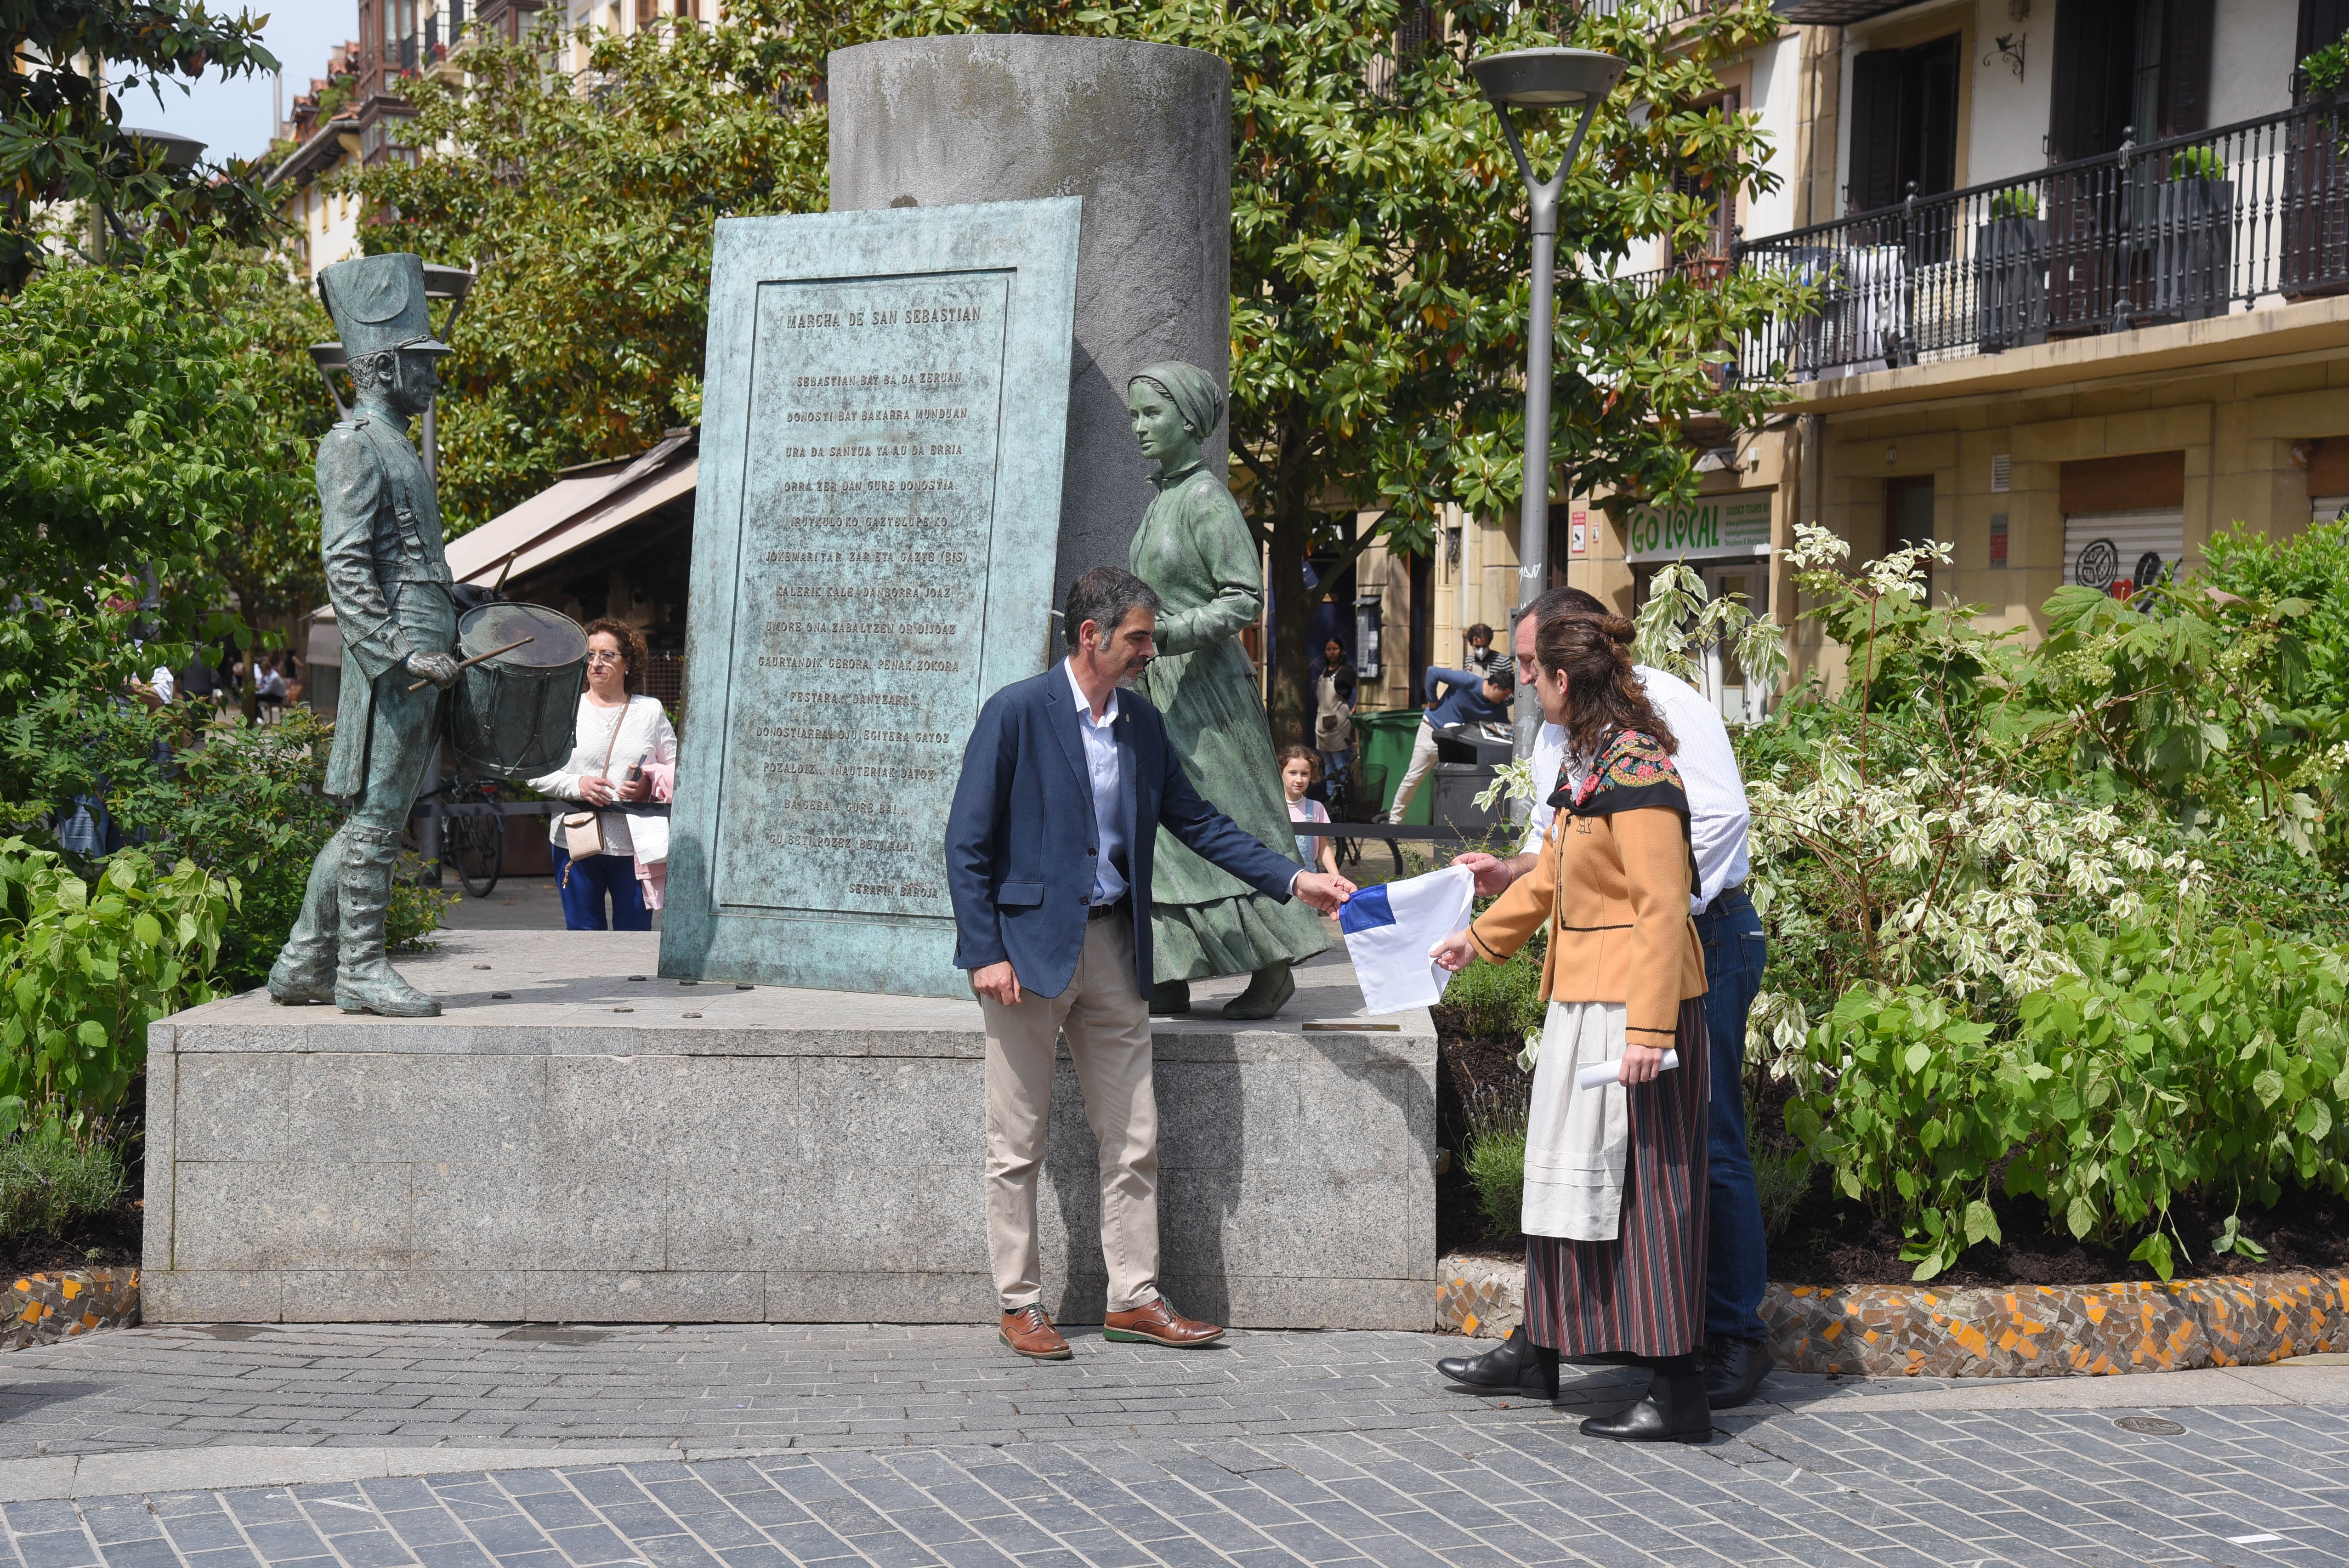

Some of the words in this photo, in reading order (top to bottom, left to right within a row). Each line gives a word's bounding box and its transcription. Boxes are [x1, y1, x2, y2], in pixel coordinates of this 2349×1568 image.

[787, 313, 840, 329] MARCHA
[849, 312, 864, 326] DE
[873, 311, 897, 325] SAN
[905, 306, 981, 324] SEBASTIAN
[797, 375, 856, 387] SEBASTIAN
[860, 375, 878, 386] BAT
[883, 374, 897, 385] BA
[902, 373, 915, 385] DA
[920, 372, 962, 384] ZERUAN
[787, 411, 833, 422] DONOSTI
[838, 411, 857, 422] BAT
[861, 409, 910, 421] BAKARRA
[915, 407, 968, 420] MUNDUAN
[786, 446, 806, 457] URA
[811, 446, 824, 457] DA
[829, 445, 872, 457] SANTUA
[877, 445, 889, 456] TA
[892, 445, 907, 456] AU
[911, 444, 925, 456] DA
[930, 443, 963, 455] ERRIA
[817, 481, 838, 492] ZER
[842, 480, 862, 491] DAN
[867, 479, 895, 491] GURE
[900, 478, 959, 491] DONOSTIA.
[866, 515, 948, 528] GAZTELUPE'KO
[1632, 511, 1659, 553] GO
[1665, 505, 1719, 549] LOCAL
[849, 551, 870, 562] ZAR
[874, 551, 894, 562] ETA
[900, 551, 935, 562] GAZTE
[940, 550, 968, 564] (BIS)
[776, 585, 822, 597] KALERIK
[827, 586, 857, 598] KALE,
[862, 586, 919, 598] DANBORRA
[924, 587, 951, 598] JOAZ
[765, 621, 802, 632] UMORE
[806, 622, 826, 633] ONA
[832, 622, 894, 634] ZABALTZEN
[899, 623, 913, 634] OR
[918, 623, 956, 635] DIJOAZ
[758, 656, 823, 668] GAURTANDIK
[878, 659, 912, 671] PENAK
[917, 659, 959, 672] ZOKORA
[790, 692, 847, 704] FESTARA...
[852, 693, 920, 706] DANTZARA...
[839, 729, 857, 740] OJU
[863, 730, 910, 742] EGITERA
[915, 732, 949, 744] GATOZ
[763, 762, 826, 775] POZALDIZ...
[831, 761, 896, 778] IÑAUTERIAK
[901, 768, 935, 780] DATOZ
[784, 798, 798, 809] BA
[803, 800, 840, 812] GERA...
[846, 801, 874, 814] GURE
[879, 803, 908, 815] BAI...
[769, 834, 783, 845] GU
[788, 835, 813, 846] BETI
[817, 836, 854, 850] POZEZ,
[859, 838, 884, 851] BETI
[849, 883, 895, 896] SERAFIN
[900, 885, 939, 899] BAROJA
